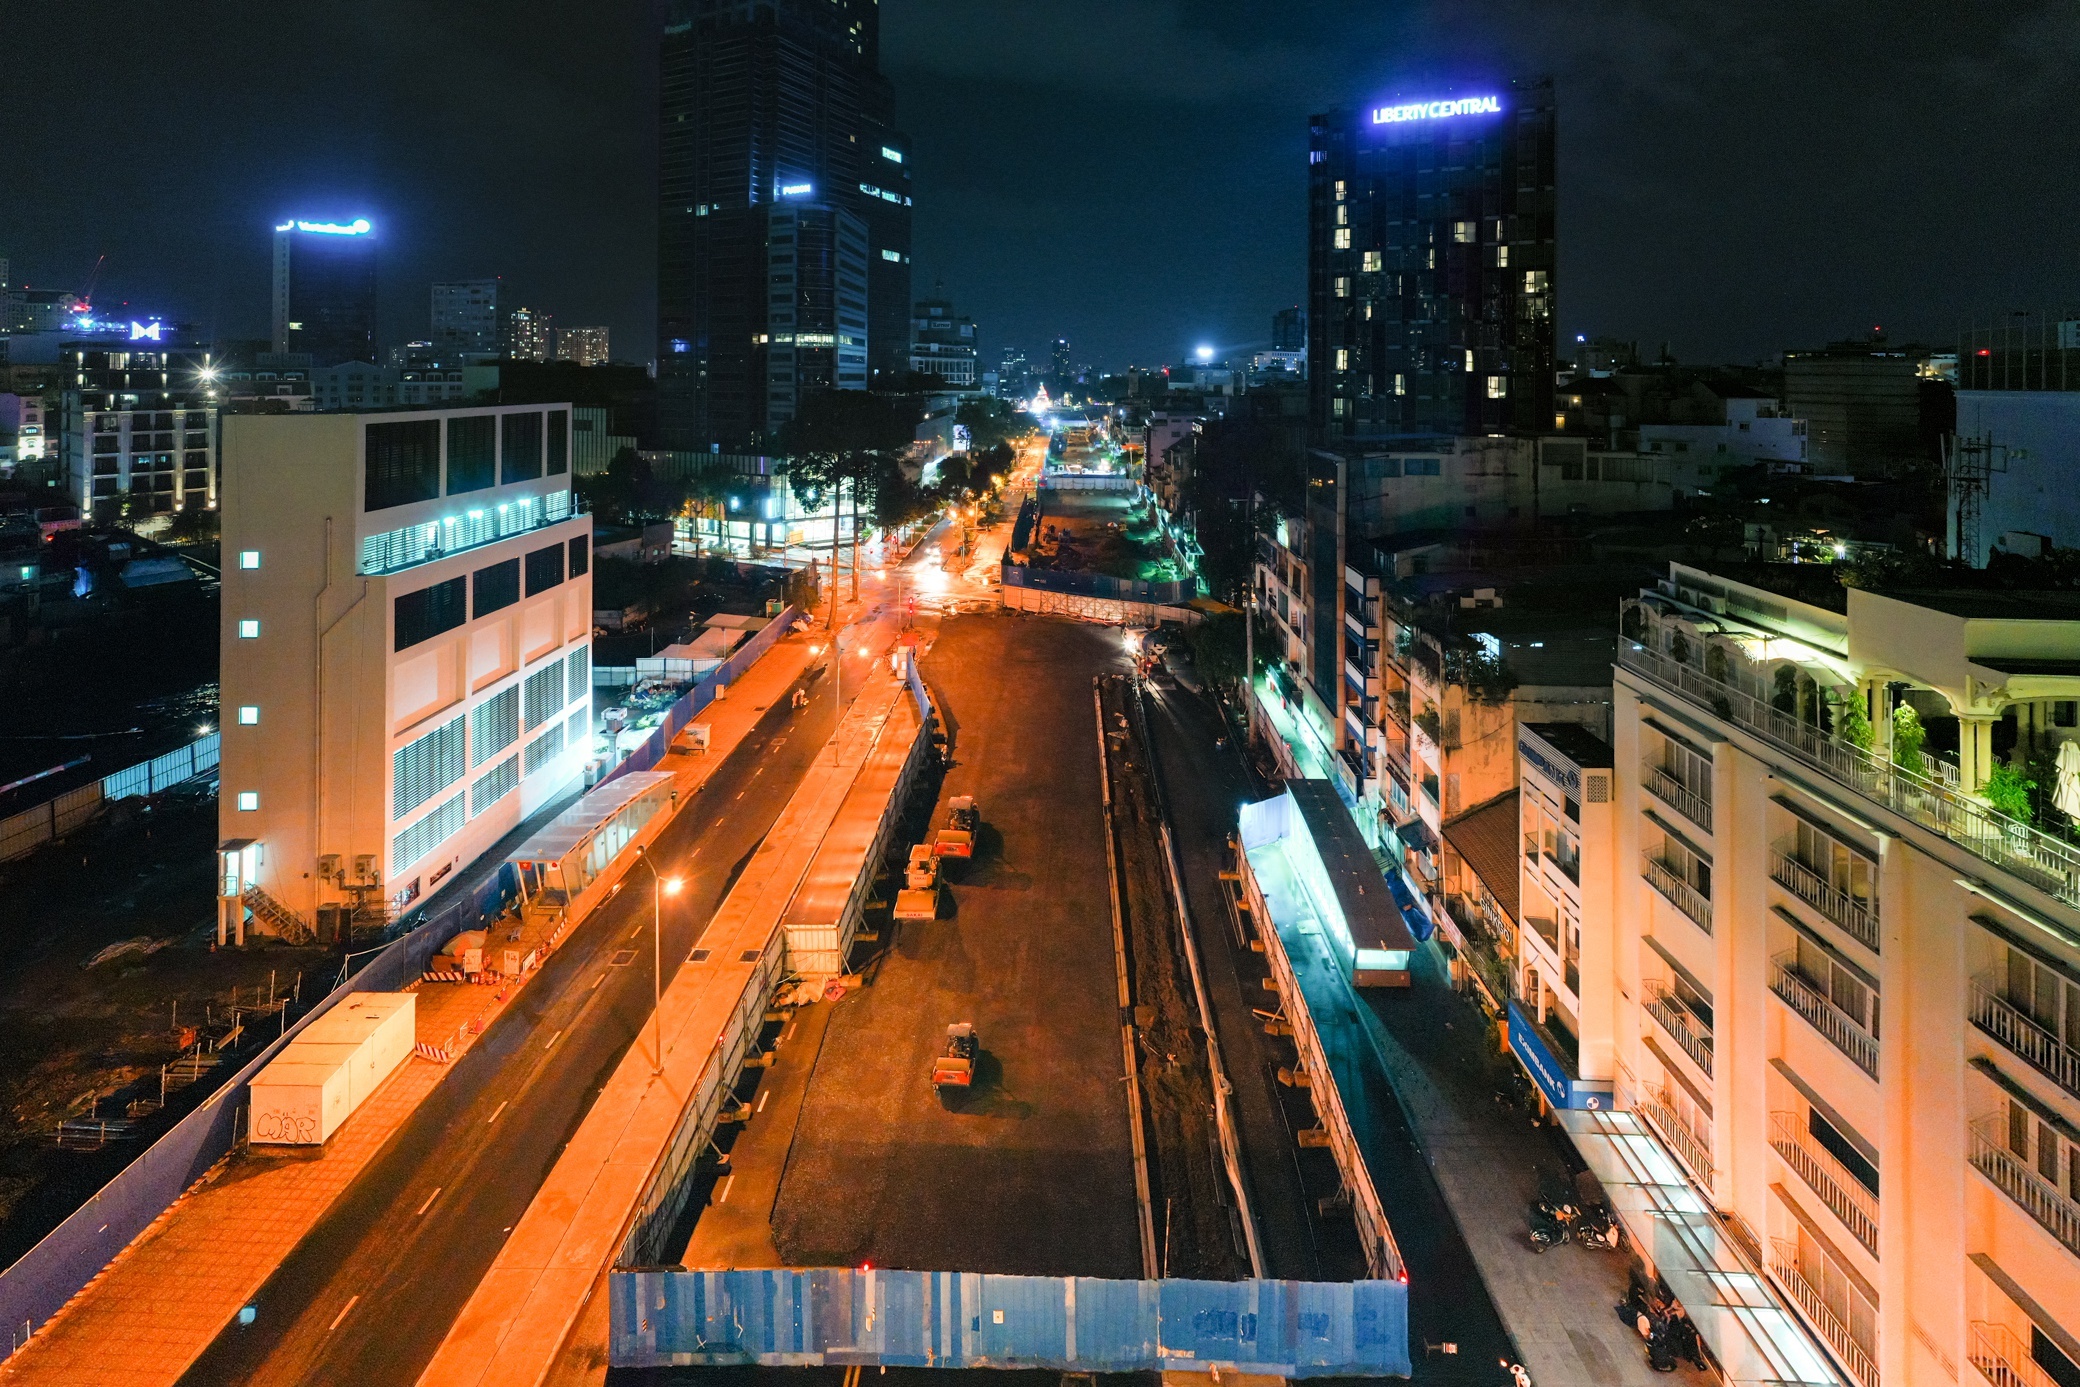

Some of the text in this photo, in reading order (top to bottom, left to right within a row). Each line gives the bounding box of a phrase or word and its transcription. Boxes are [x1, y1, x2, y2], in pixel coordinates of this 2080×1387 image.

[1372, 96, 1501, 124] LIBERTY CENTRAL
[1518, 739, 1566, 787] EBANK
[1480, 897, 1510, 943] GINKGO
[1518, 1032, 1556, 1092] EXIMBANK
